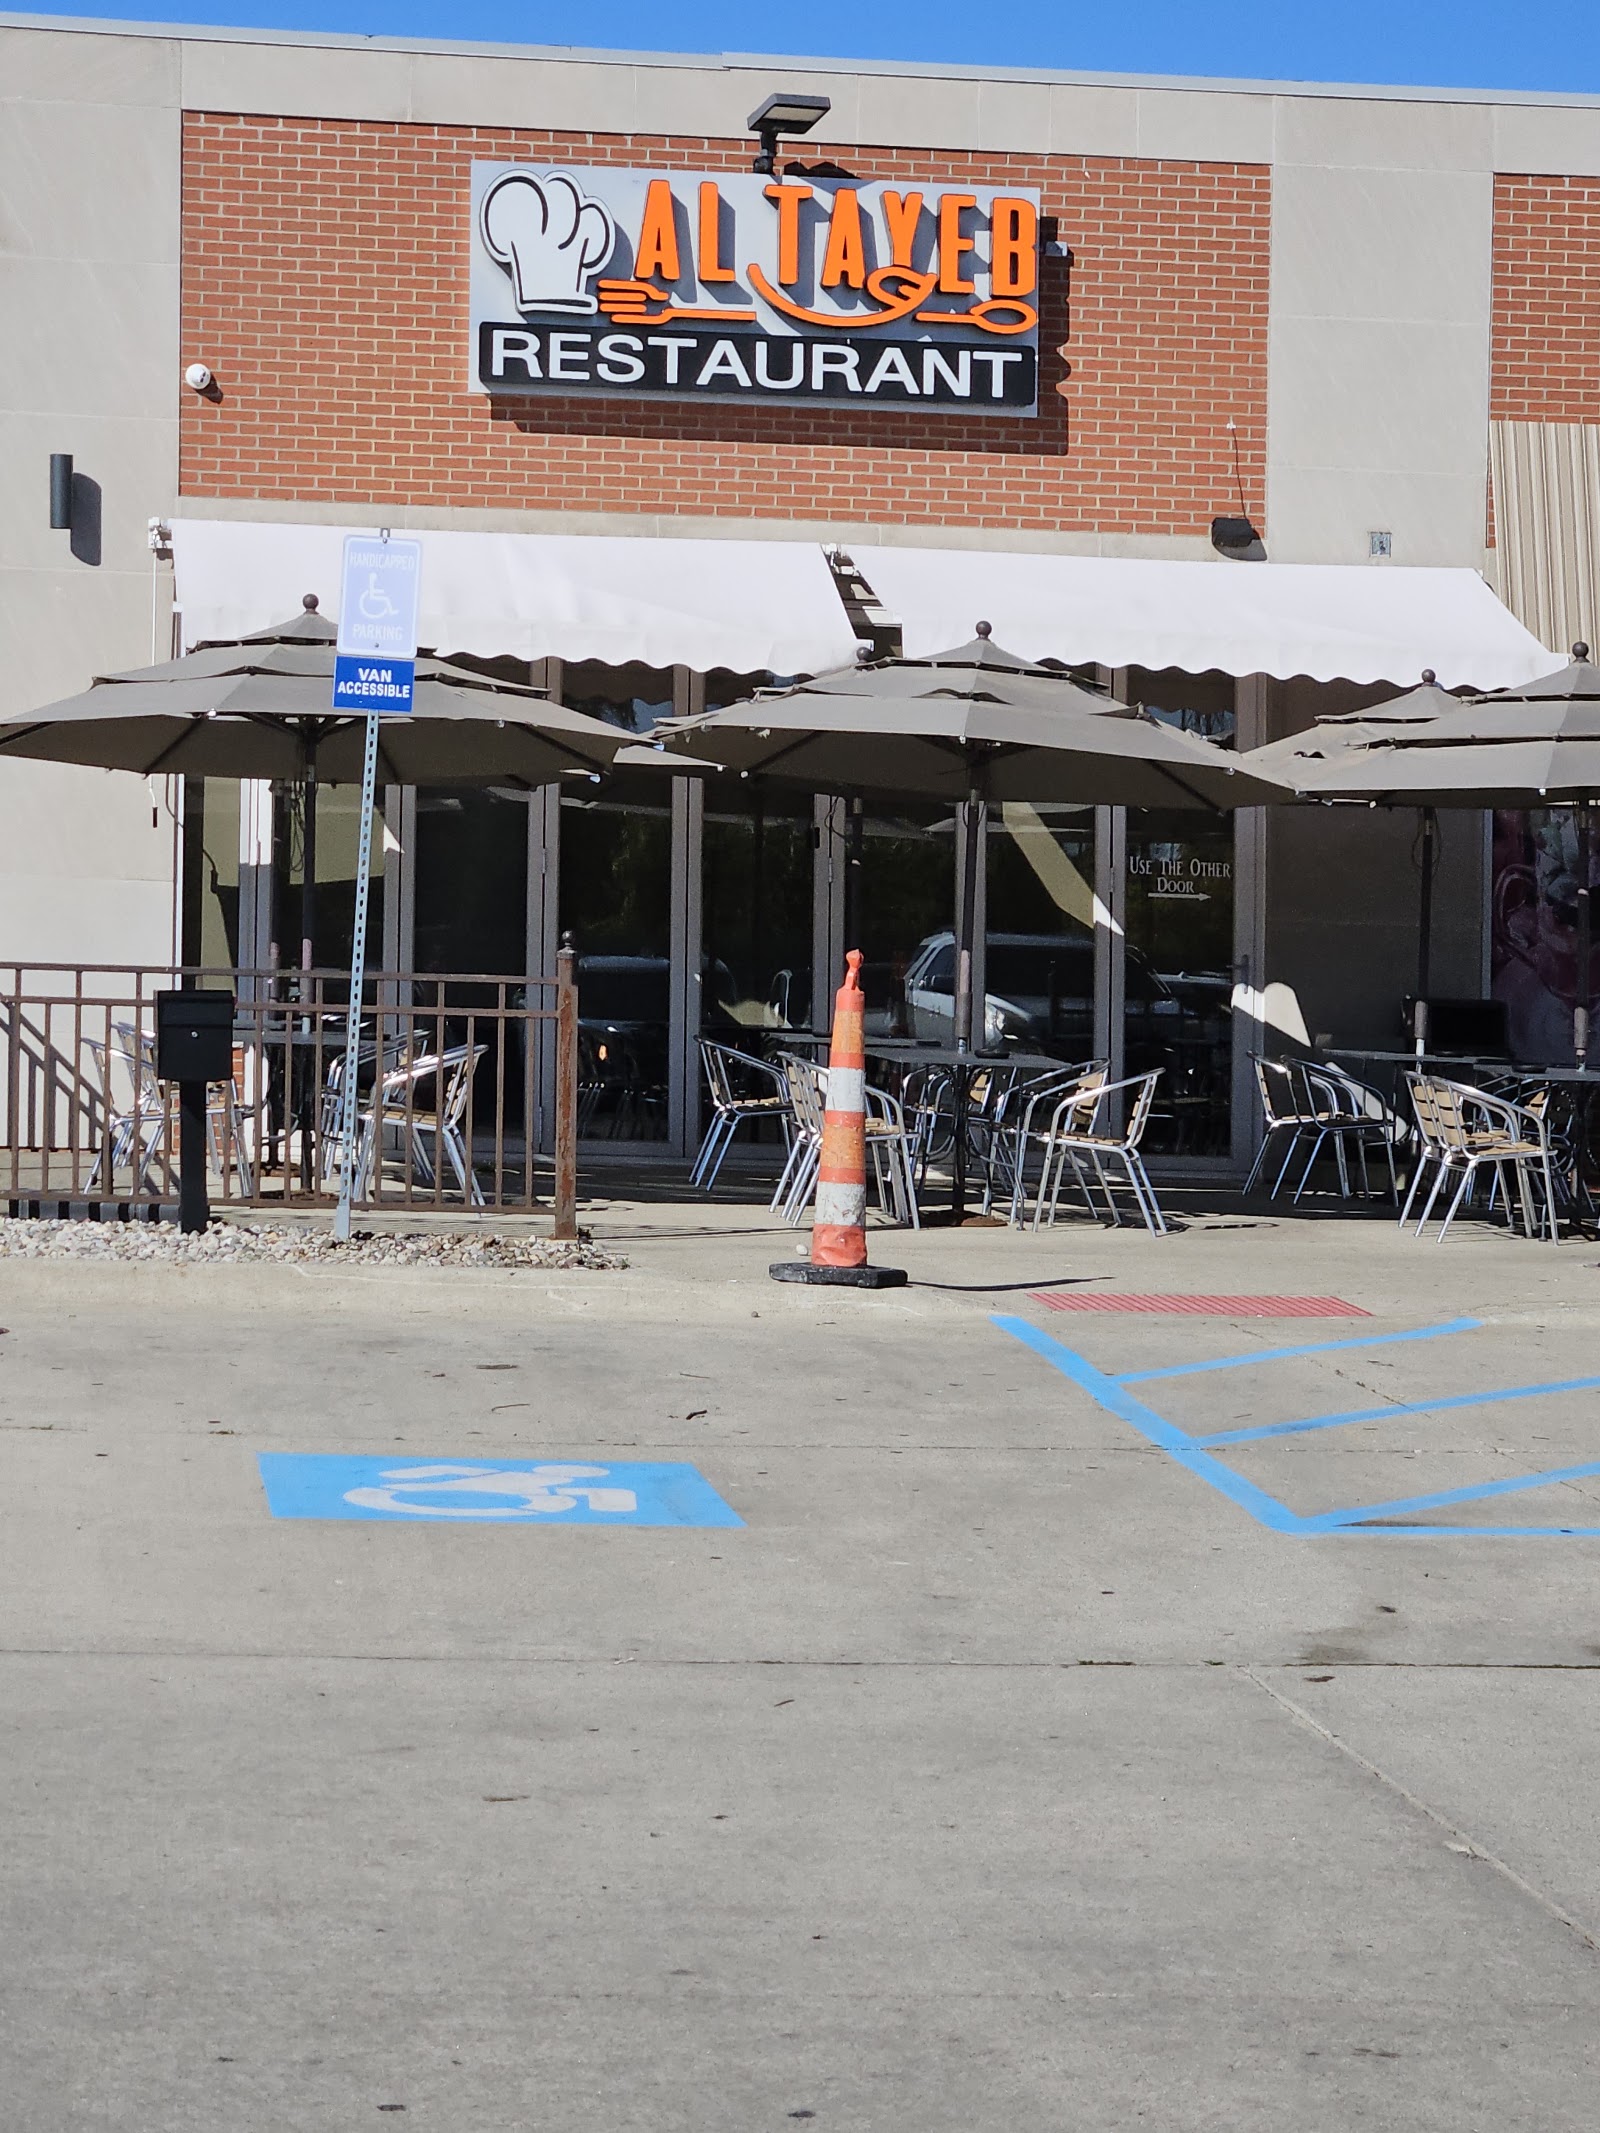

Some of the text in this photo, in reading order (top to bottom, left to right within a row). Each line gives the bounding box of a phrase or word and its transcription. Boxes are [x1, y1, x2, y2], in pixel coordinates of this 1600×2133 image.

[634, 179, 1038, 297] AL TAYEB
[491, 329, 1022, 398] RESTAURANT
[350, 552, 415, 570] HANDICAPPED
[352, 624, 403, 640] PARKING
[358, 668, 392, 682] VAN
[338, 682, 410, 698] ACCESSIBLE
